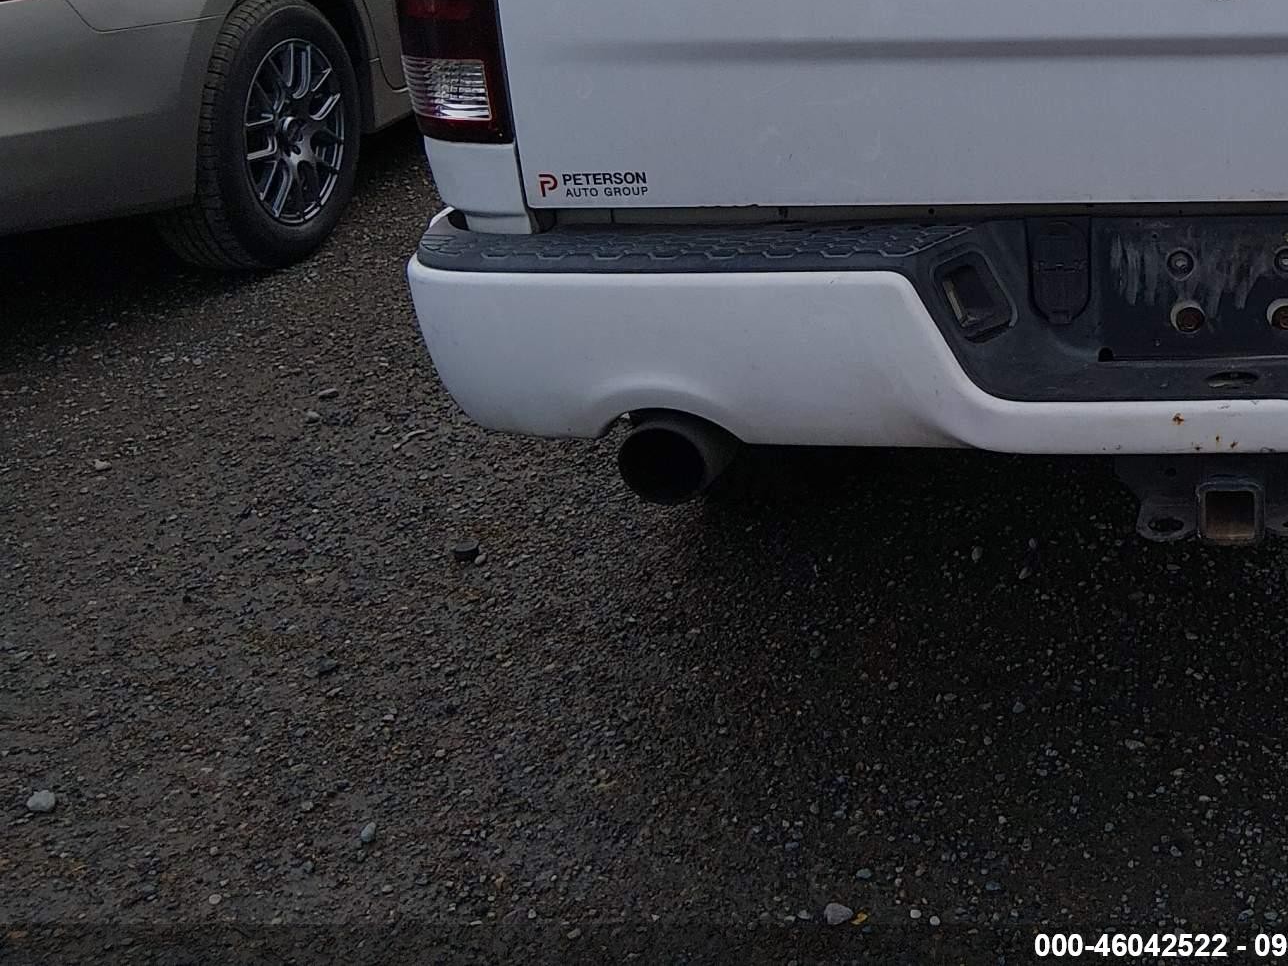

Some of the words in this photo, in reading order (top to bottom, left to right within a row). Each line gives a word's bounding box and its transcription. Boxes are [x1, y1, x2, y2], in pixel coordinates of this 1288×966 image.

[562, 172, 647, 186] PETERSON
[565, 187, 599, 198] AUTO
[604, 186, 648, 197] GROUP
